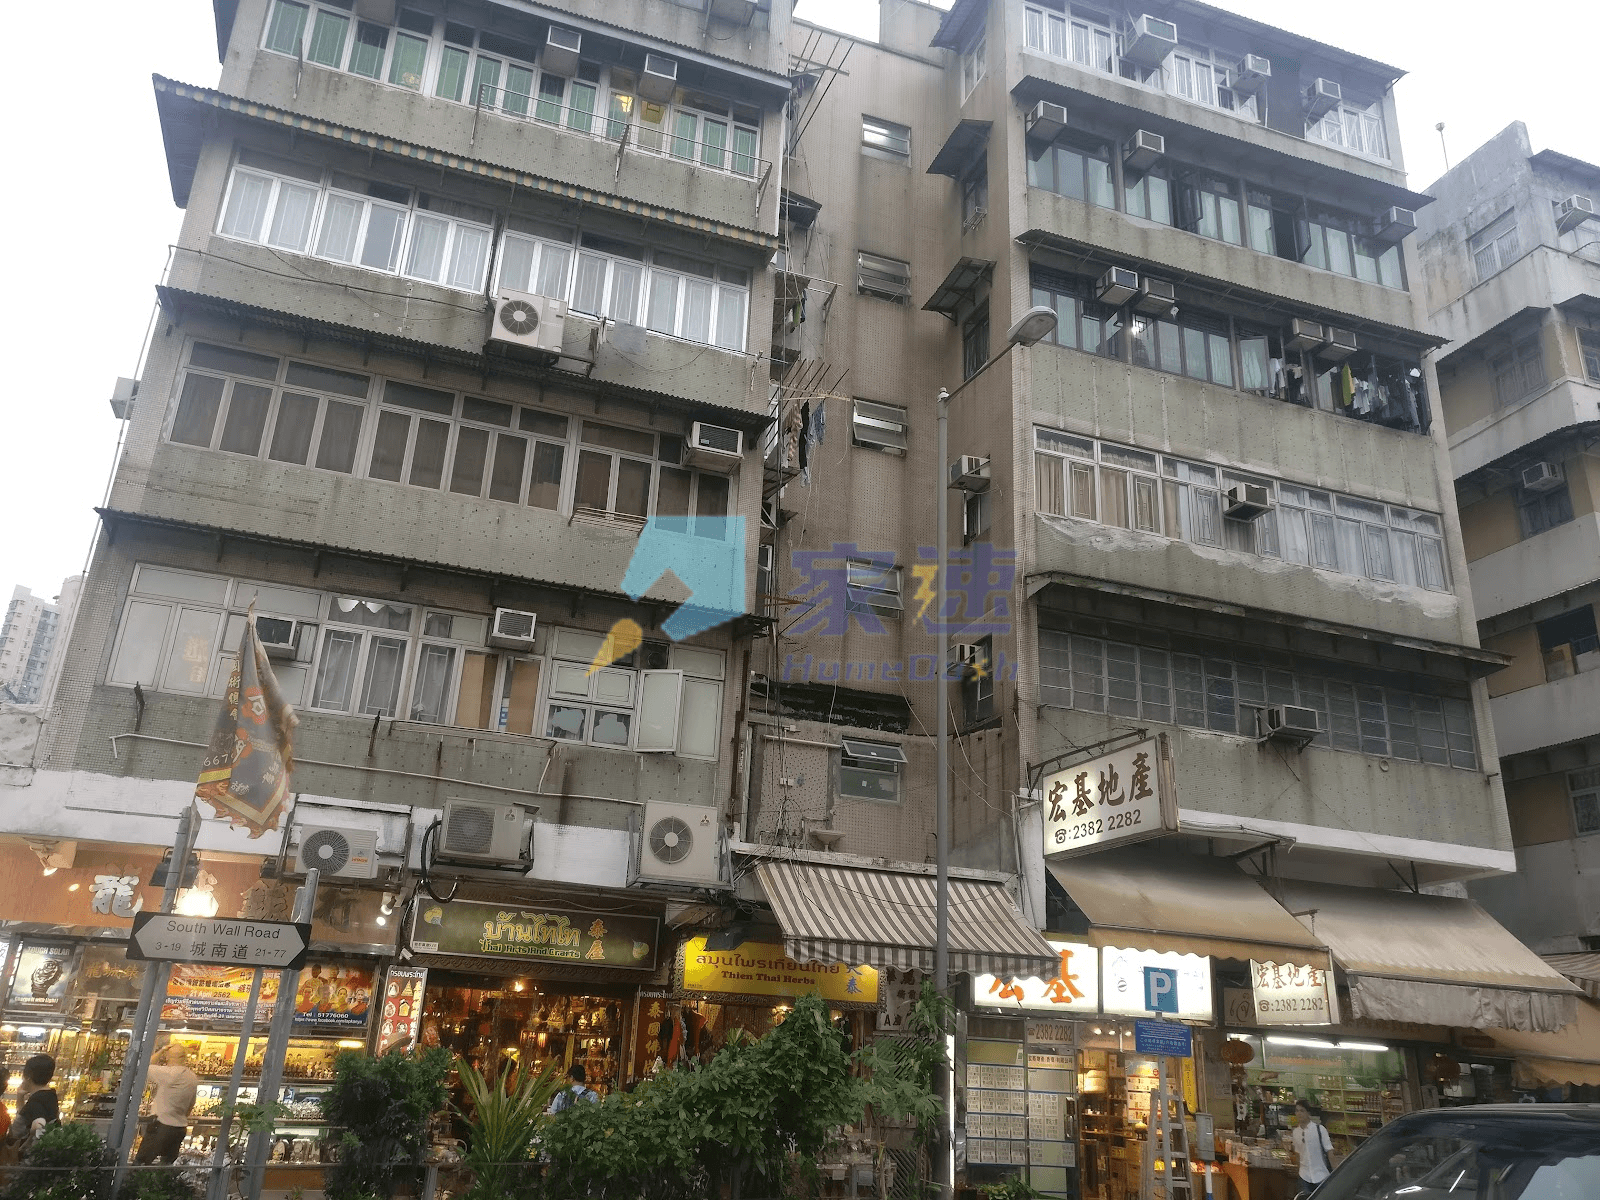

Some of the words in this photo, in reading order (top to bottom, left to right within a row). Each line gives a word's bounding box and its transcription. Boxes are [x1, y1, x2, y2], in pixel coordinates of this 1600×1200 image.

[1049, 752, 1153, 822] 宏基地產
[1108, 809, 1141, 831] 2282
[166, 920, 207, 934] South
[212, 923, 241, 937] Wall
[244, 925, 281, 940] Road
[49, 947, 70, 956] SOLAR
[190, 942, 248, 960] 城南道
[480, 939, 502, 953] Thai
[549, 948, 581, 958] Crafts
[721, 970, 753, 982] Thien
[756, 972, 781, 983] Thai
[783, 974, 816, 985] Herbs
[1150, 972, 1172, 1007] P
[1301, 998, 1324, 1011] 2282
[1036, 1024, 1054, 1040] 2382
[1055, 1025, 1073, 1042] 2282
